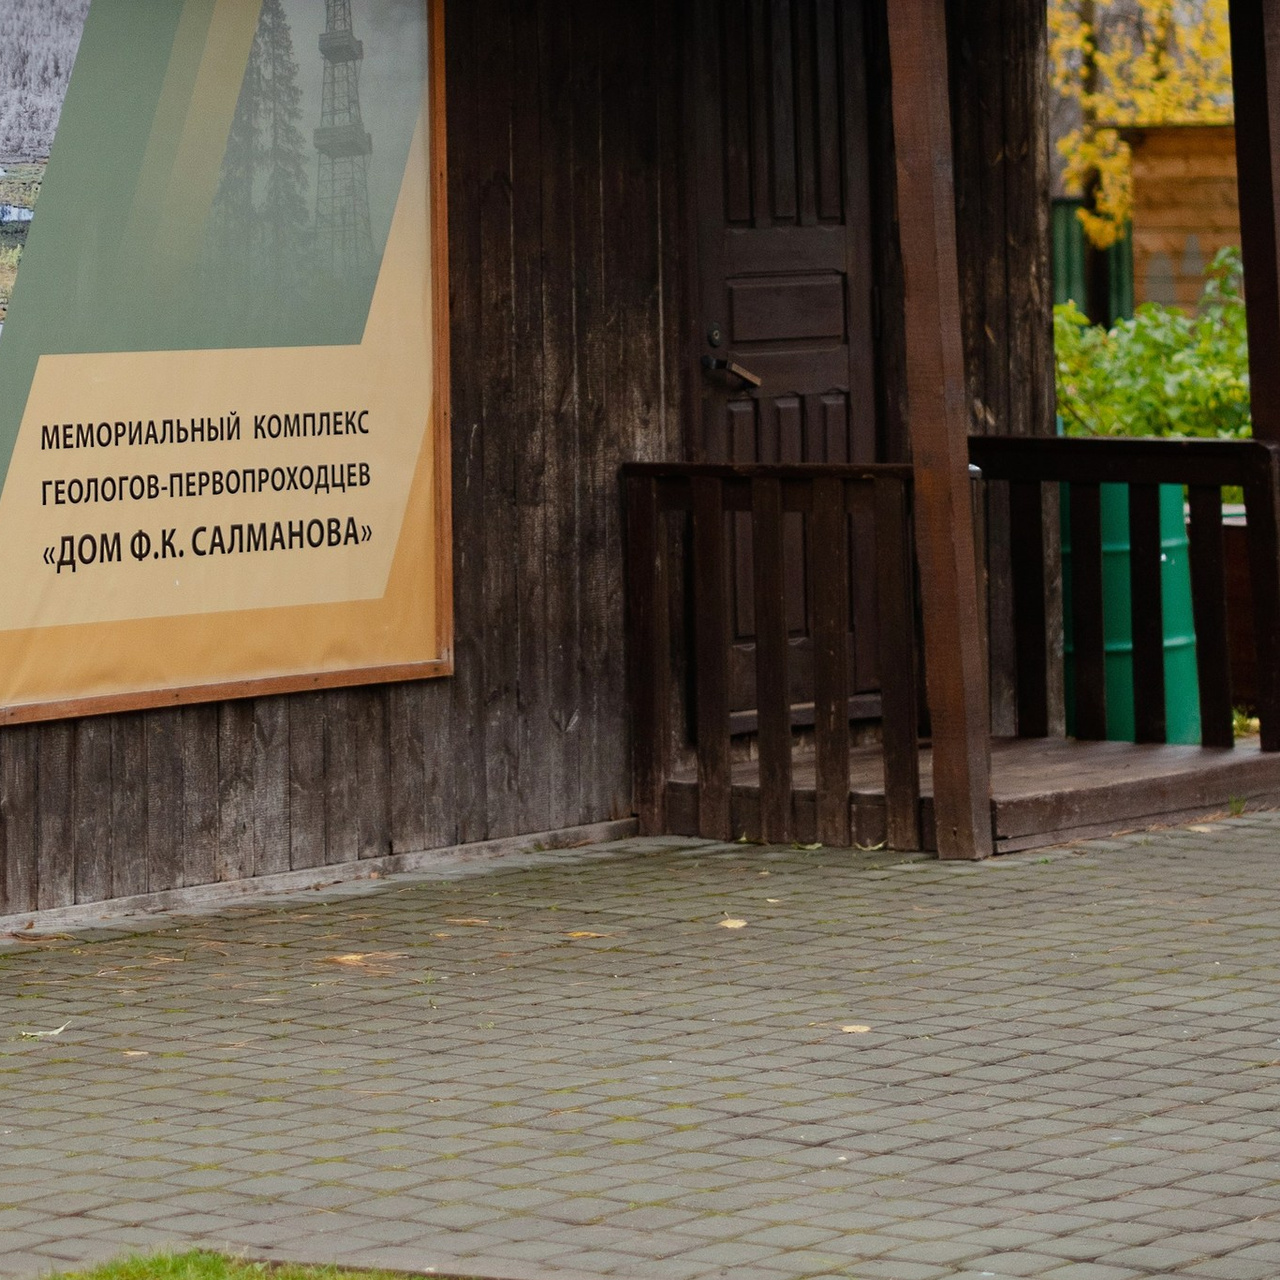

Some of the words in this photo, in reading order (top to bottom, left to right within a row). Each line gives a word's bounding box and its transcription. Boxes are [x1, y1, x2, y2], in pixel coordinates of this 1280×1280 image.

[41, 411, 241, 450] МЕМОРИАЛЬНЫЙ
[254, 410, 369, 440] КОМПЛЕКС
[42, 462, 371, 506] ГЕОЛОГОВ-ПЕРВОПРОХОДЦЕВ
[43, 532, 122, 573] «ДОМ
[130, 528, 184, 562] Ф.К.
[191, 516, 373, 556] САЛМАНОВА»
